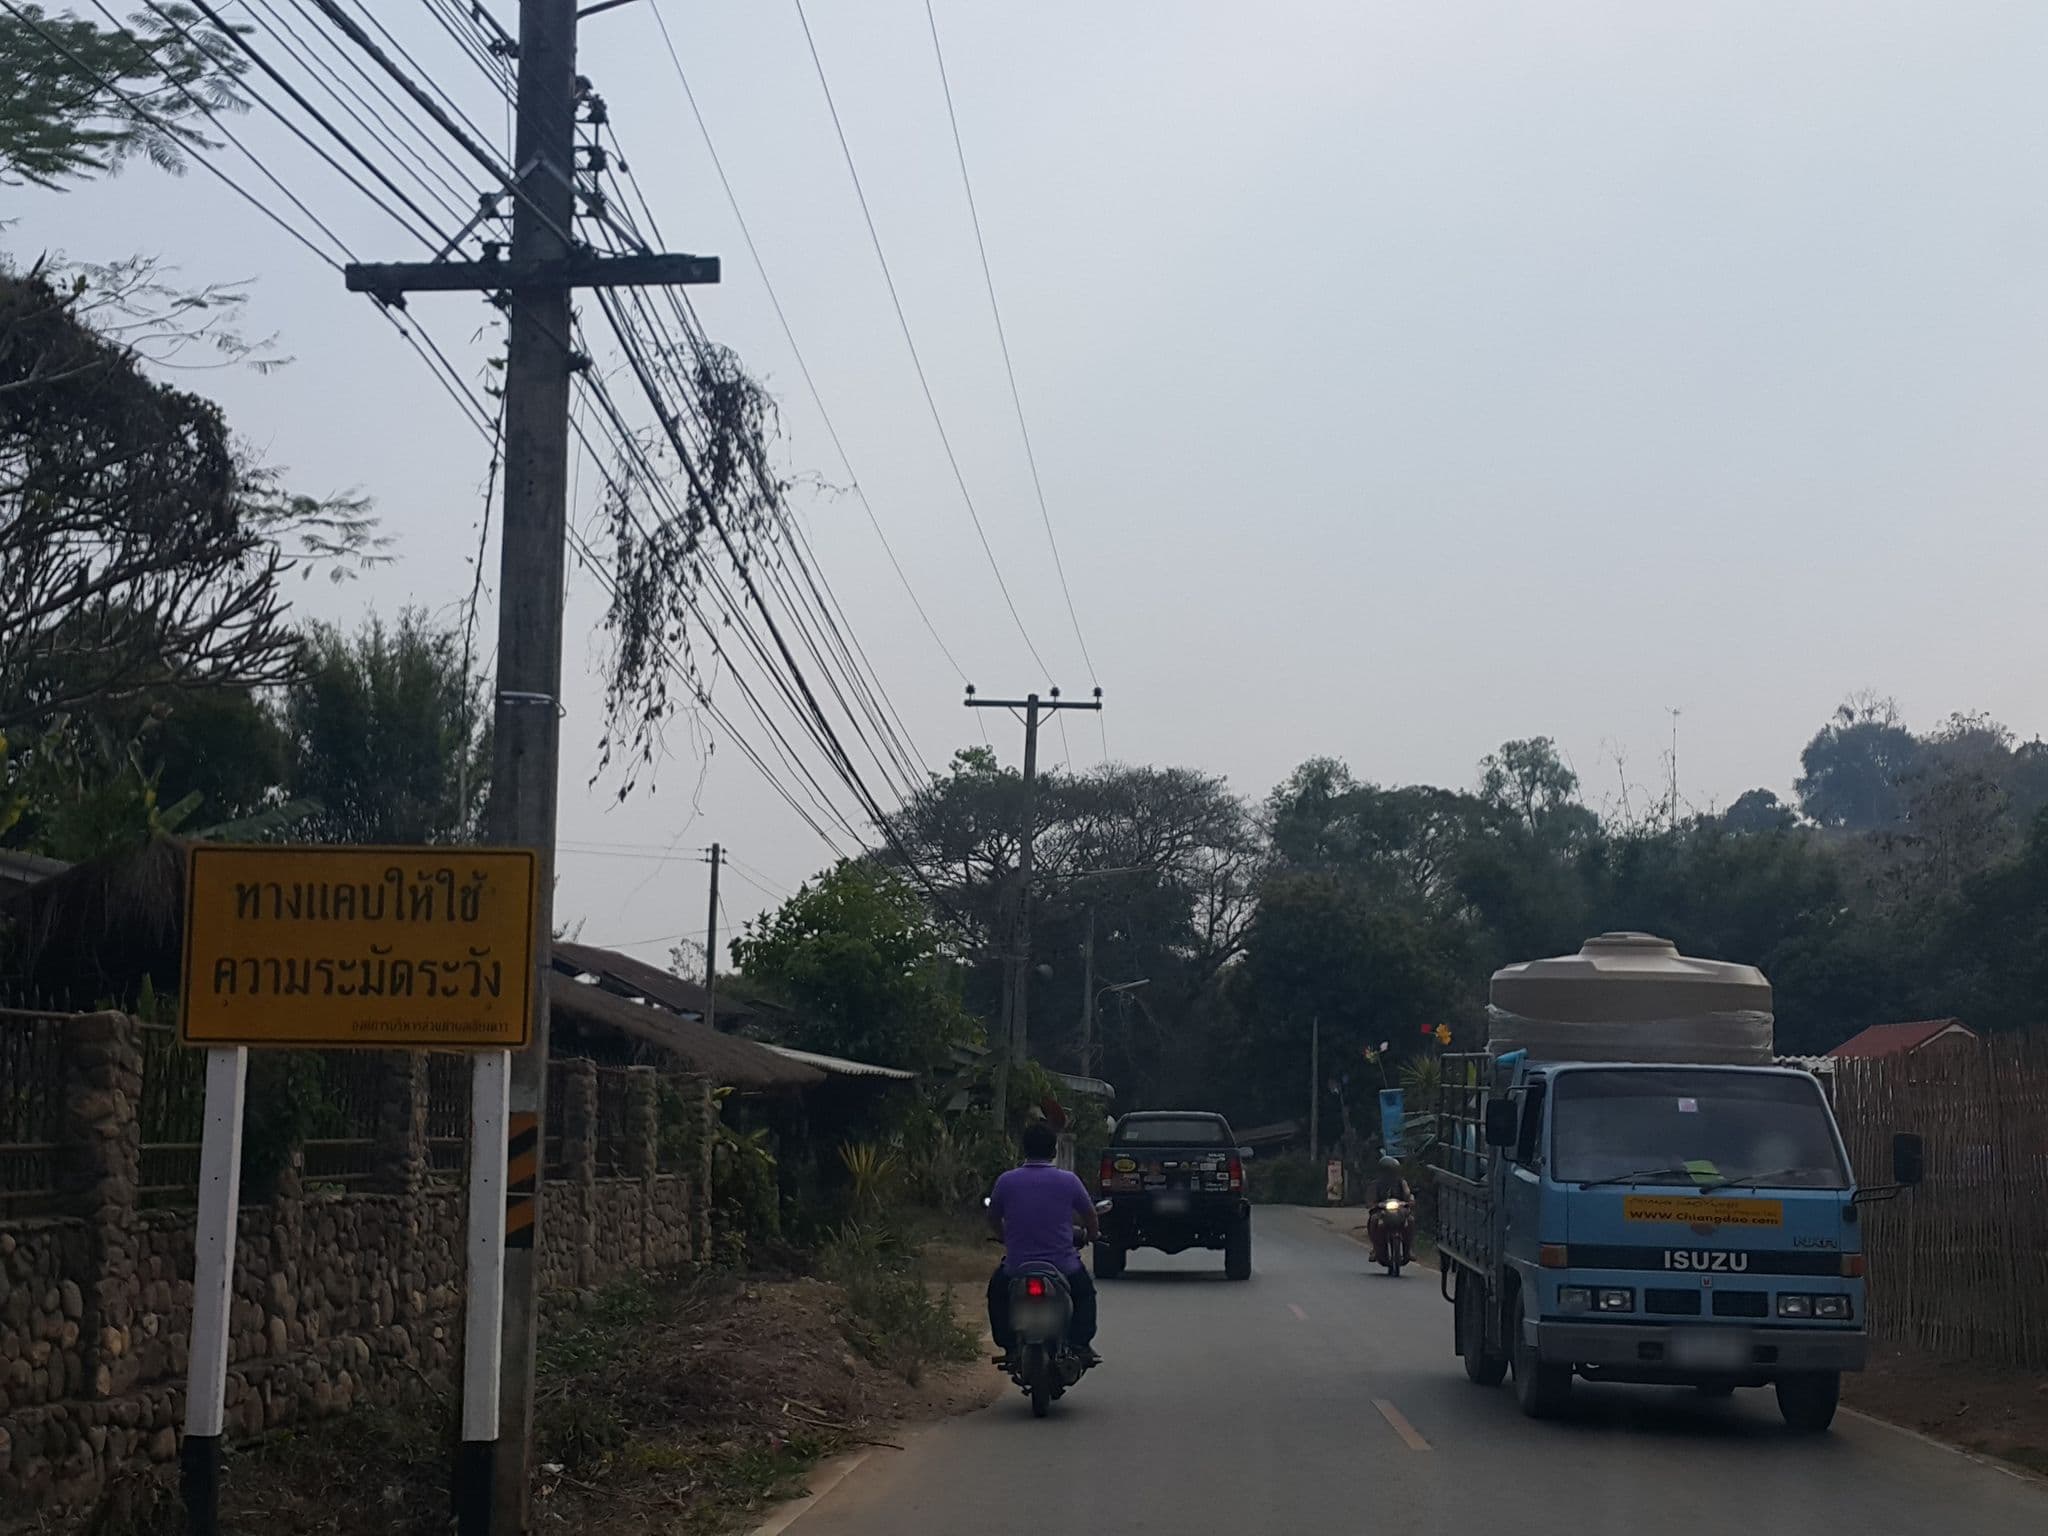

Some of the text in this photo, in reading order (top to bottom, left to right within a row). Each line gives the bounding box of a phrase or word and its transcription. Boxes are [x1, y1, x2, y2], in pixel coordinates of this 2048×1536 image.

[235, 867, 488, 922] ทางแคบให้ใช้
[213, 943, 502, 998] ความระมัดระวัง
[1664, 1250, 1748, 1272] ISUZU
